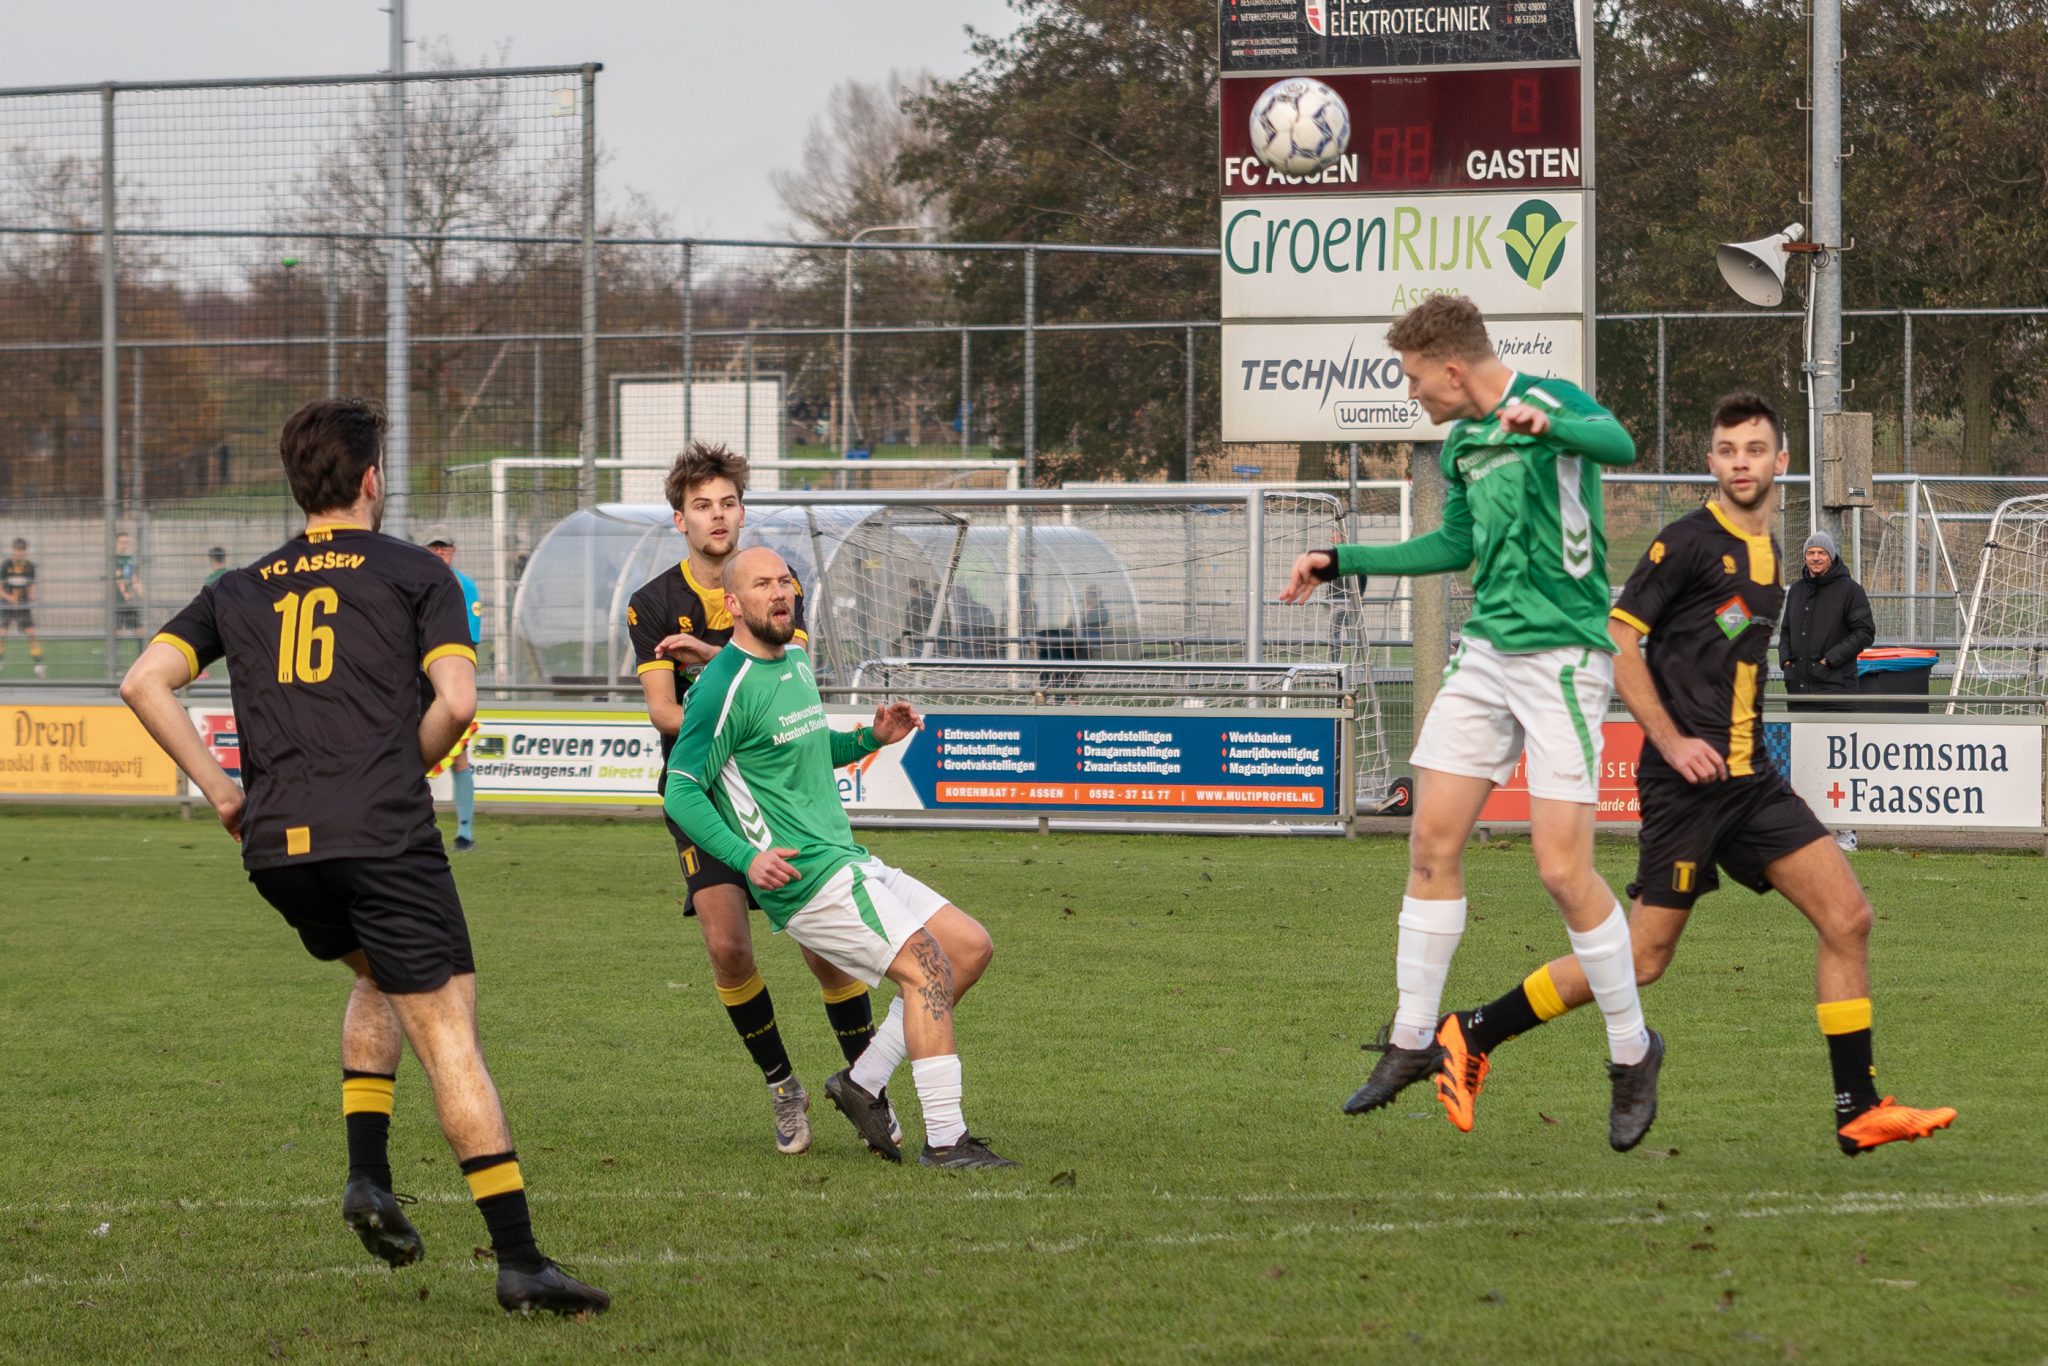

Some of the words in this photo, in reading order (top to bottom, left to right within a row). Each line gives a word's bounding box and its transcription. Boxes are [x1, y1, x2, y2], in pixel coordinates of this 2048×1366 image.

[1330, 5, 1491, 37] ELEKTROTECHNIEK
[1225, 156, 1260, 186] FC
[1466, 148, 1580, 180] GASTEN
[260, 559, 288, 581] FC
[294, 551, 365, 573] ASSEN
[273, 586, 338, 683] 16
[1083, 729, 1173, 744] Legbordstellingen
[1228, 731, 1292, 743] Werkbanken
[512, 734, 594, 757] Greven
[944, 743, 1020, 757] Palletstellingen
[1083, 745, 1181, 759] Draagarmstellingen
[1826, 731, 2009, 772] Bloemsma
[1228, 747, 1319, 762] Aanrijdbeveiliging
[598, 766, 643, 779] Direct
[944, 759, 1036, 774] Grootvakstellingen
[1083, 760, 1181, 775] Zwaarlaststellingen
[1228, 762, 1324, 777] Magazijnkeuringen
[945, 787, 1008, 798] KORENMAAT
[1010, 788, 1018, 798] 7
[1029, 788, 1064, 799] ASSEN
[1088, 789, 1115, 799] 0592
[1125, 790, 1138, 800] 37
[1141, 790, 1154, 800] 11
[1157, 790, 1171, 800] 77
[1196, 790, 1315, 803] WWW.MULTIPROFIEL.NL
